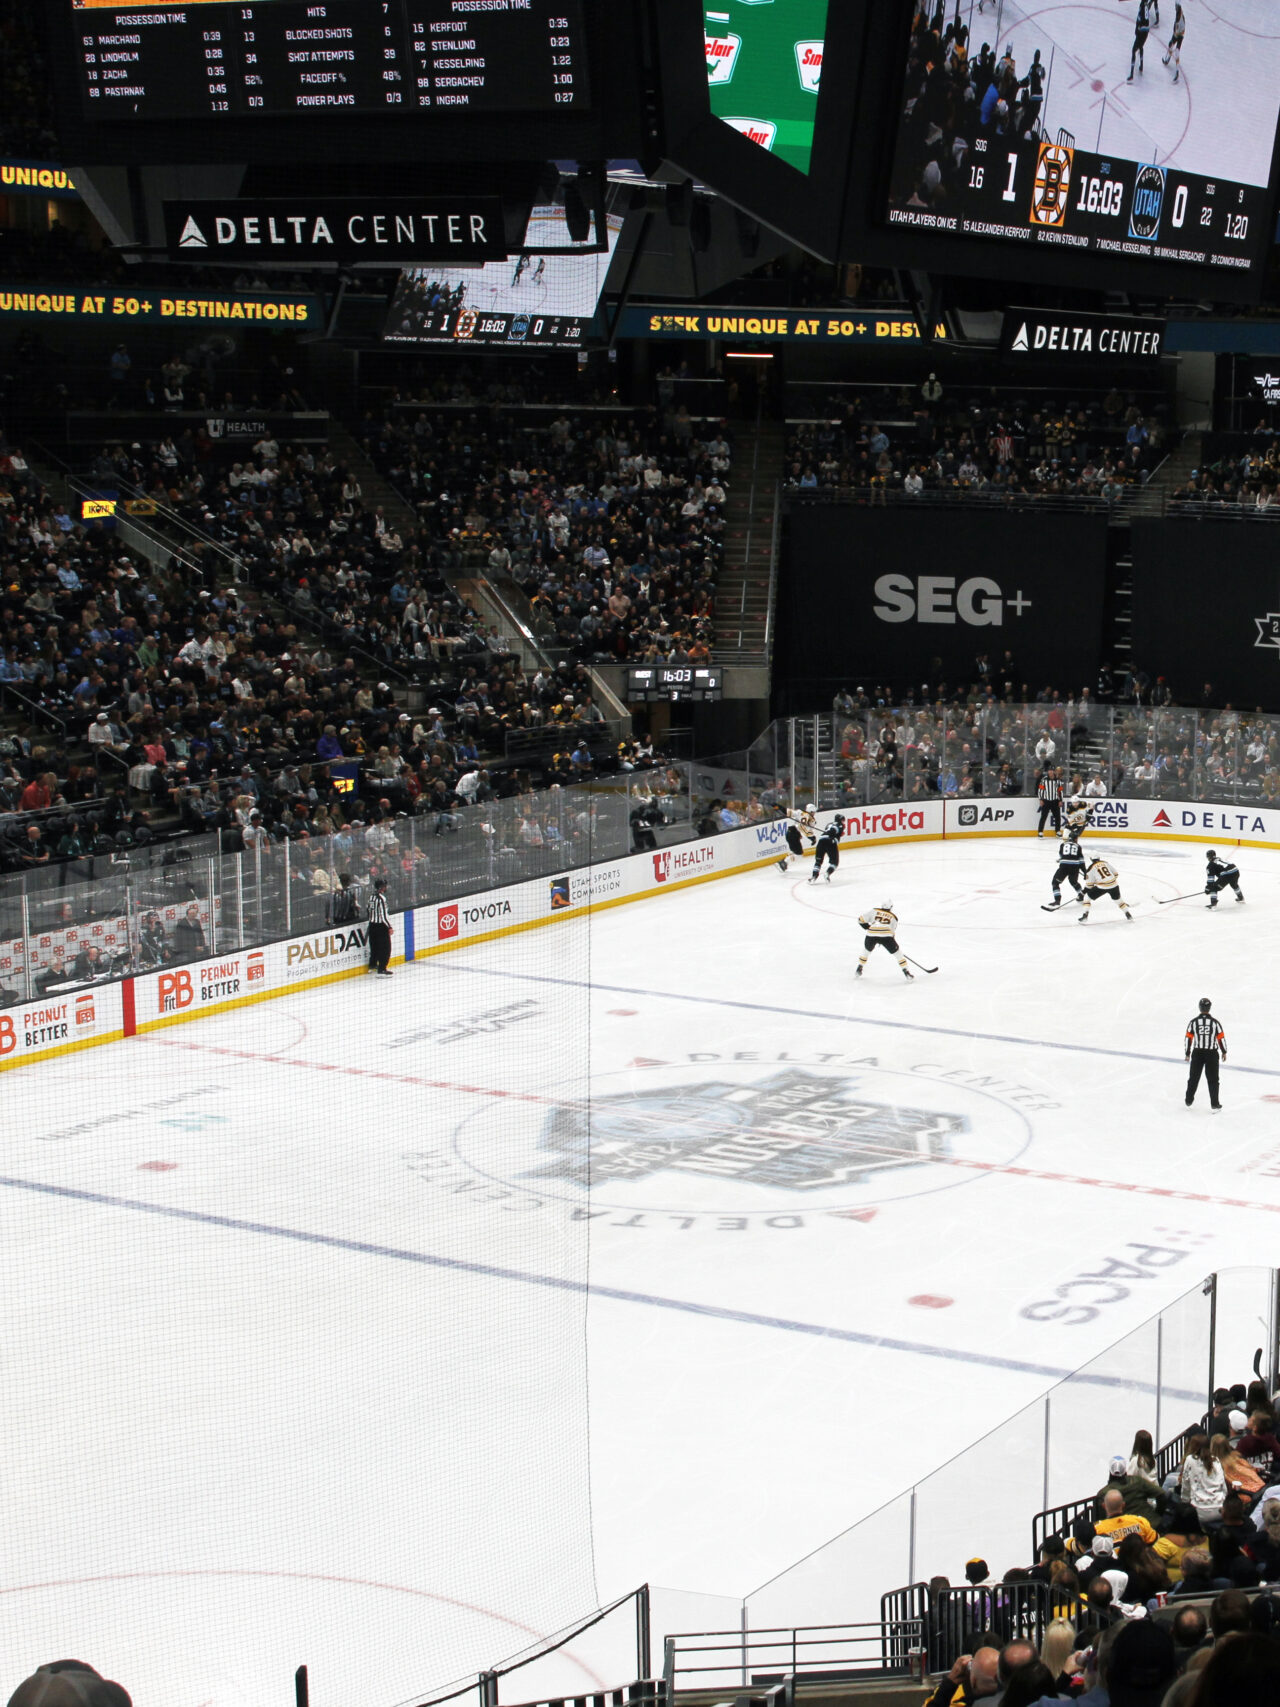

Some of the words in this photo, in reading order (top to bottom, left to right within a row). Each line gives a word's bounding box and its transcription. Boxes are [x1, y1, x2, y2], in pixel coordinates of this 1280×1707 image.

[307, 7, 326, 17] HITS
[382, 3, 389, 13] 7
[452, 0, 508, 11] POSSESSION
[510, 0, 531, 9] TIME
[115, 14, 167, 26] POSSESSION
[168, 13, 187, 23] TIME
[242, 9, 253, 19] 19
[413, 23, 424, 33] 15
[430, 22, 467, 32] KERFOOT
[549, 18, 568, 28] 0:35
[98, 34, 141, 45] MARCHAND
[203, 31, 221, 41] 0:39
[244, 32, 254, 41] 13
[286, 30, 324, 40] BLOCKED
[325, 28, 352, 39] SHOTS
[384, 26, 391, 36] 6
[414, 41, 426, 51] 82
[431, 40, 476, 51] STENLUND
[550, 37, 569, 47] 0:23
[100, 52, 139, 62] LINDHOLM
[205, 49, 223, 59] 0:28
[246, 53, 257, 64] 34
[288, 52, 309, 62] SHOT
[311, 50, 355, 61] ATTEMPTS
[384, 49, 396, 59] 39
[421, 60, 427, 69] 7
[433, 58, 485, 69] KESSELRING
[552, 55, 571, 65] 1:22
[88, 70, 98, 80] 18
[102, 70, 128, 80] ZACHA
[207, 67, 225, 76] 0:35
[245, 75, 263, 85] 52%
[300, 73, 337, 83] FACEOFF
[382, 70, 401, 81] 48%
[417, 78, 429, 88] 98
[435, 77, 485, 87] SERGACHEV
[553, 74, 573, 84] 1:00
[104, 86, 145, 97] PASTRNAK
[209, 84, 227, 94] 0:45
[248, 96, 264, 107] 0/3
[296, 96, 326, 106] POWER
[327, 95, 355, 105] PLAYS
[386, 93, 402, 104] 0/3
[436, 95, 469, 105] INGRAM
[554, 92, 574, 103] 0:27
[211, 101, 229, 112] 1:12
[975, 138, 988, 152] SOG
[968, 165, 984, 189] 16
[1002, 152, 1018, 202] 1
[1076, 174, 1124, 217] 16:03
[1171, 184, 1188, 229] 0
[1200, 206, 1213, 226] 22
[1238, 189, 1244, 203] 9
[1134, 188, 1162, 219] UTAH
[889, 209, 910, 225] UTAH
[908, 211, 936, 227] PLAYERS
[936, 216, 947, 228] ON
[946, 217, 957, 230] ICE
[1224, 212, 1249, 240] 1:20
[215, 216, 334, 245] DELTA
[348, 214, 488, 245] CENTER
[963, 220, 970, 231] 15
[970, 220, 1005, 236] ALEXANDER
[1004, 226, 1031, 240] KERFOOT
[1037, 230, 1045, 241] 82
[1045, 231, 1063, 244] KEVIN
[1061, 234, 1089, 247] STENLUND
[1100, 239, 1122, 252] MICHAEL
[0, 293, 75, 313] UNIQUE
[81, 296, 106, 314] AT
[112, 297, 153, 315] 50+
[160, 300, 308, 321] DESTINATIONS
[479, 318, 506, 333] 16:03
[534, 319, 544, 336] 0
[706, 316, 789, 335] UNIQUE
[794, 319, 821, 336] AT
[826, 320, 868, 337] 50+
[1033, 325, 1093, 352] DELTA
[1099, 328, 1161, 355] CENTER
[227, 422, 265, 433] HEALTH
[874, 573, 1032, 627] SEG+
[663, 669, 692, 682] 16:03
[841, 808, 925, 837] ntrata
[1182, 811, 1266, 833] DELTA
[1062, 843, 1078, 856] 82
[673, 846, 714, 869] HEALTH
[571, 877, 592, 890] UTAH
[594, 869, 621, 884] SPORTS
[571, 880, 621, 900] COMMISSION
[462, 900, 512, 924] TOYOTA
[201, 959, 240, 983] PEANUT
[201, 978, 240, 1001] BETTER
[24, 1004, 68, 1029] PEANUT
[25, 1022, 68, 1047] BETTER
[1199, 1025, 1210, 1035] 22
[688, 1051, 878, 1067] DELTA
[910, 1062, 1063, 1113] CENTER
[570, 1207, 804, 1231] DELTA
[1019, 1242, 1191, 1326] PACS
